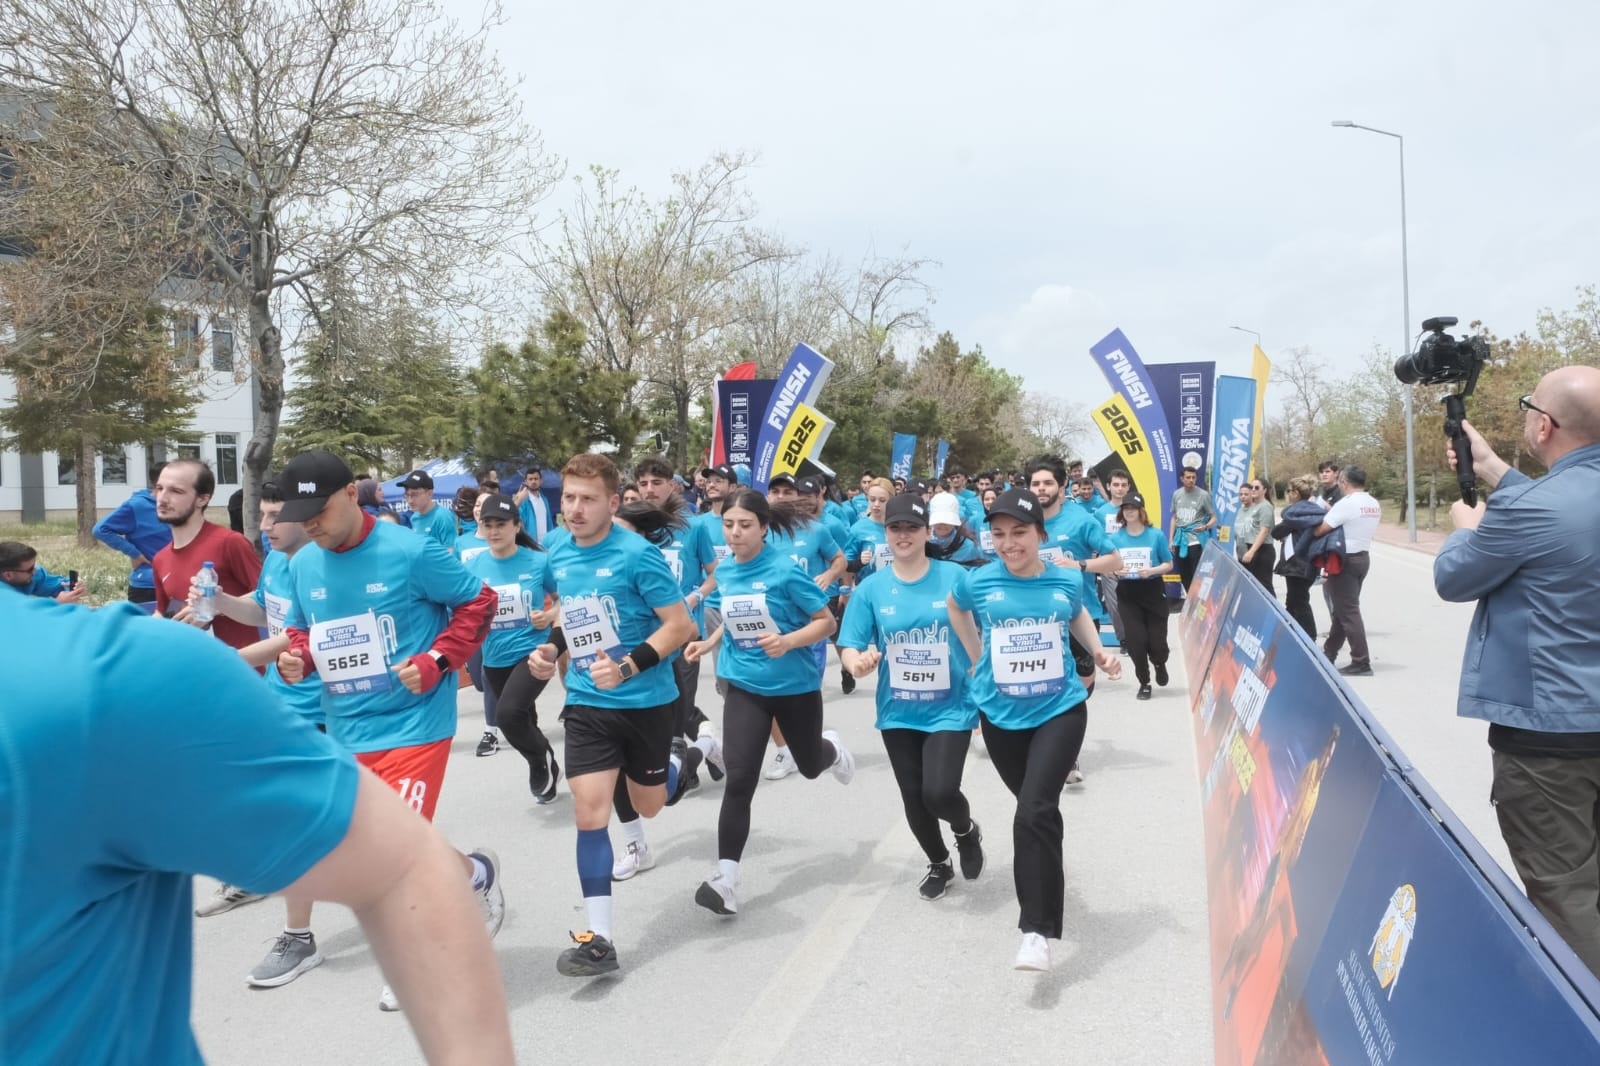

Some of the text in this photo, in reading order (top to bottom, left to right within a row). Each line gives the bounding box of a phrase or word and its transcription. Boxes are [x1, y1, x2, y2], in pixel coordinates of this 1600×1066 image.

[1105, 348, 1153, 409] FINISH
[768, 362, 812, 431] FINISH
[1101, 403, 1143, 456] 2025
[783, 415, 817, 468] 2025
[1225, 418, 1250, 513] KONYA
[736, 622, 766, 631] 6390
[320, 636, 368, 650] MARATONU
[573, 631, 602, 648] 6379
[1011, 633, 1040, 641] KONYA
[1002, 643, 1050, 653] MARATONU
[328, 653, 370, 671] 5652
[1009, 659, 1046, 673] 7144
[903, 671, 935, 682] 5614
[398, 777, 427, 815] 18
